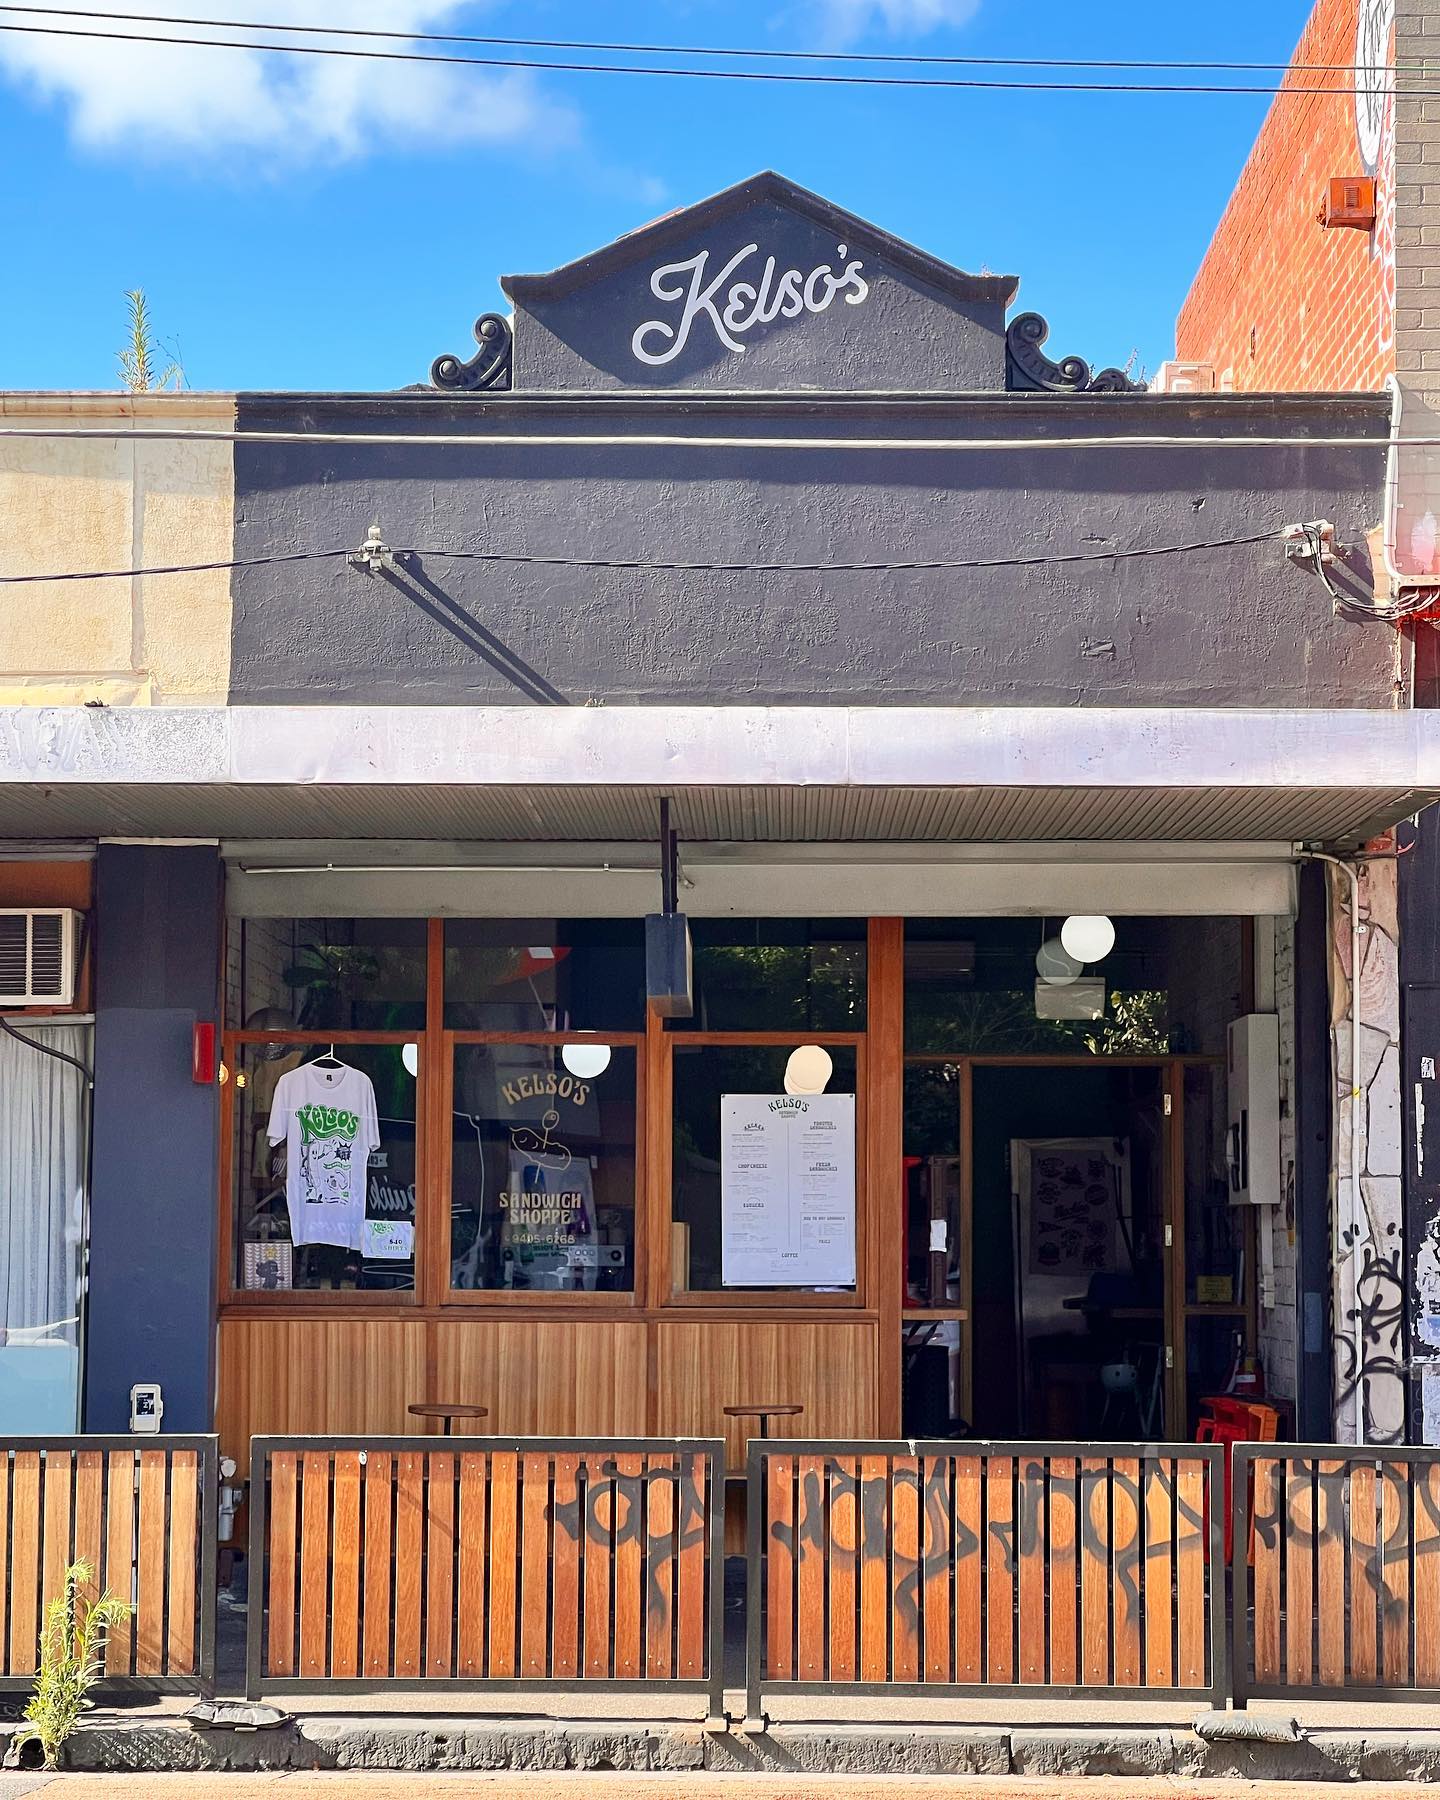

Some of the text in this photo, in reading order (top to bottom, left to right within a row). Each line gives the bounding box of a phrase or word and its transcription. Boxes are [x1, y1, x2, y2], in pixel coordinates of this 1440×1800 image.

[632, 243, 869, 366] Kelso's
[501, 1073, 591, 1106] KELSO'S
[768, 1098, 810, 1113] KELSO'S
[499, 1192, 582, 1209] SANDWICH
[510, 1209, 572, 1226] SHOPPE
